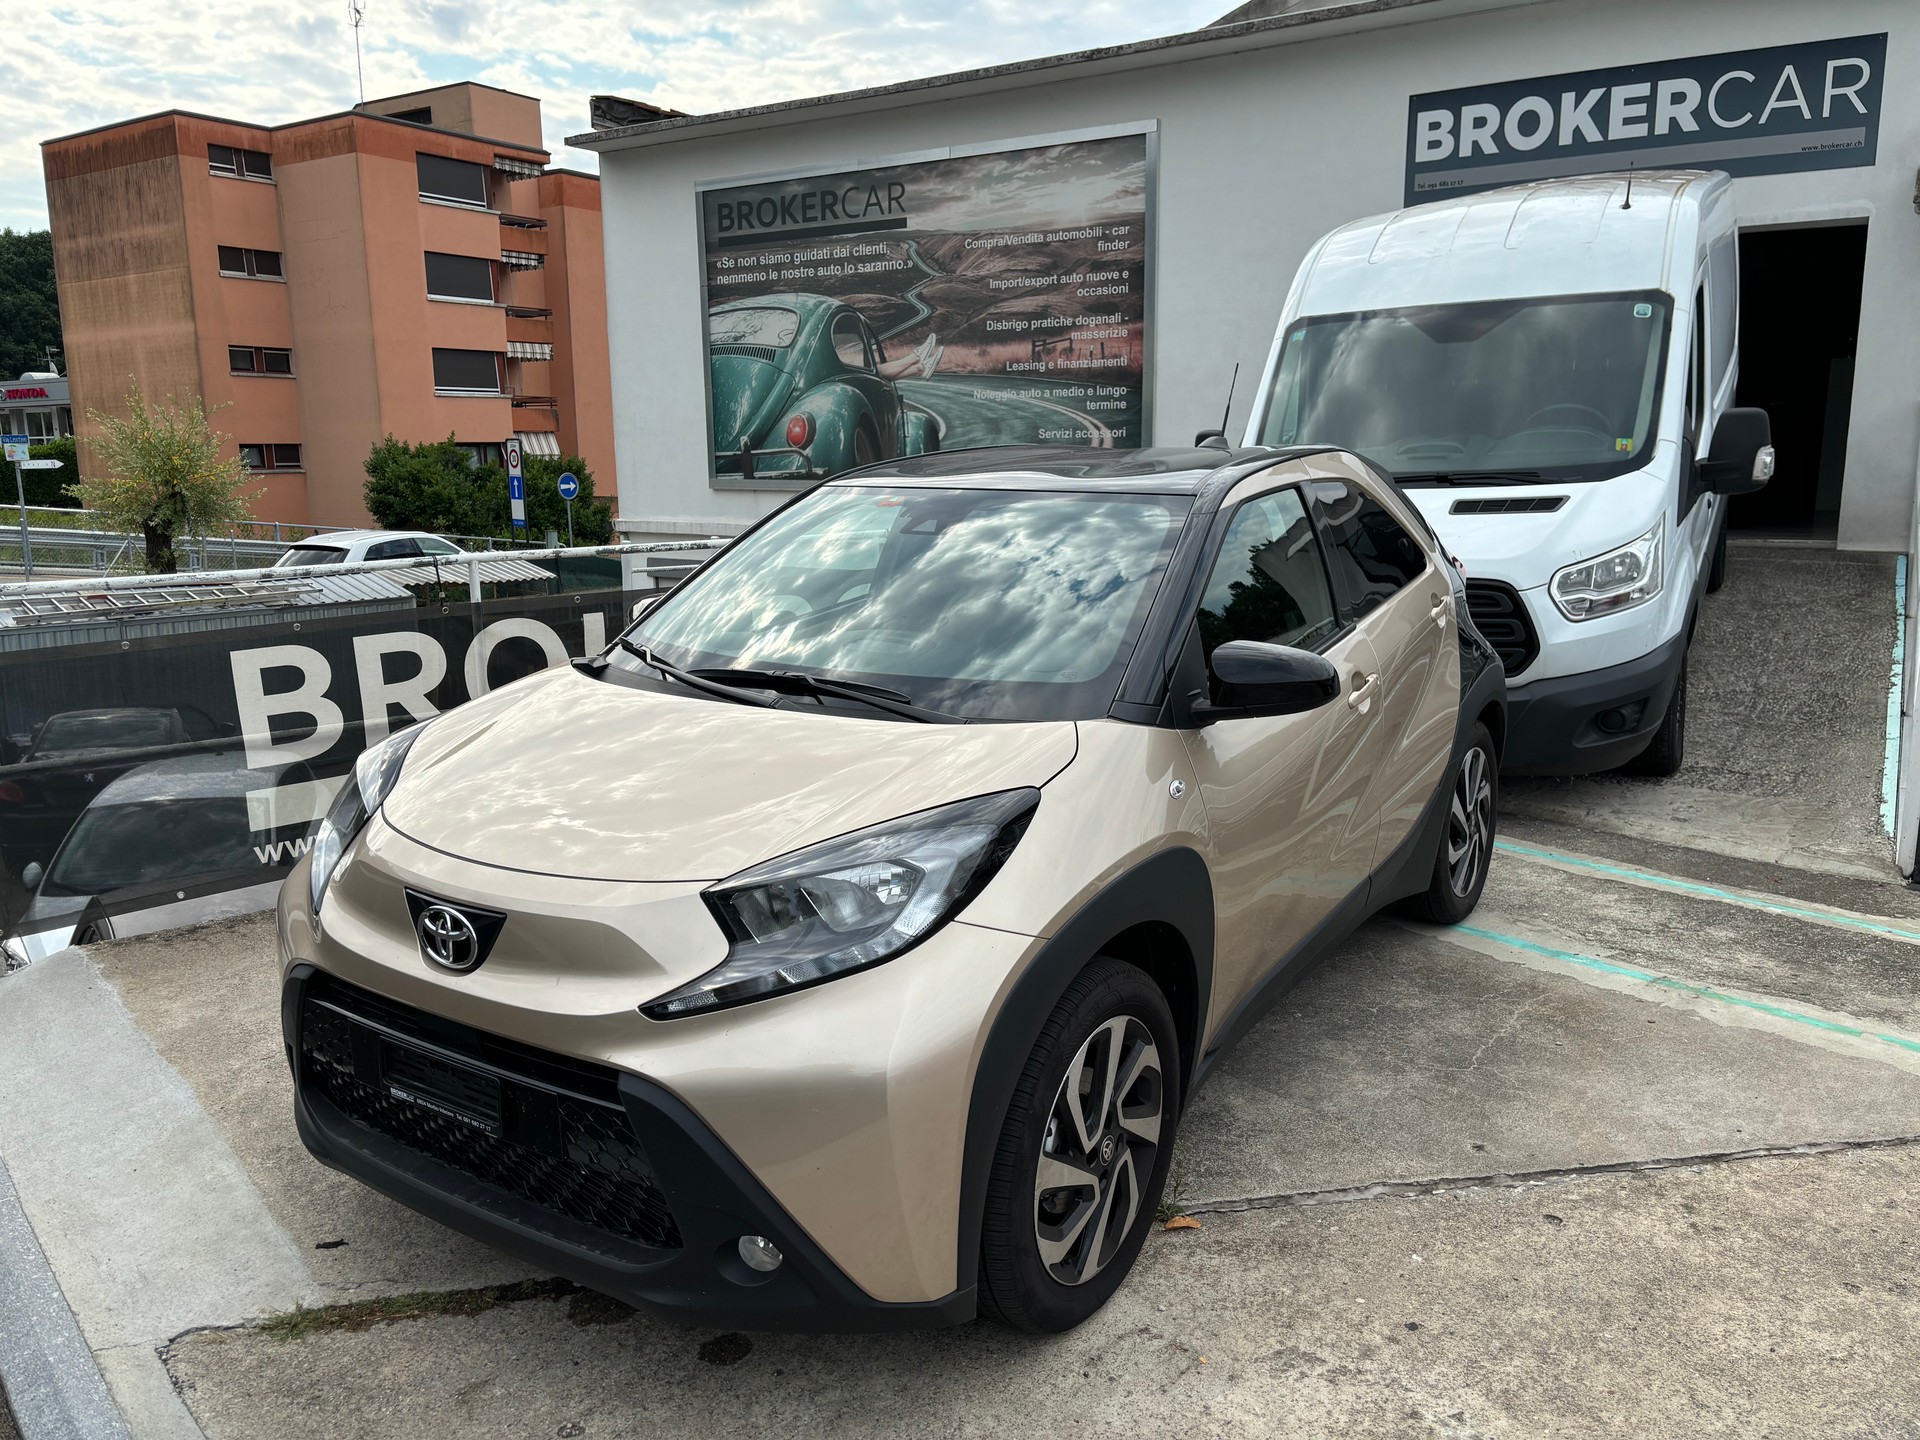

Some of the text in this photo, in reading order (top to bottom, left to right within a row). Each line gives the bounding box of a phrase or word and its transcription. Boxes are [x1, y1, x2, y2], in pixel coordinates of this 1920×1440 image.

[1414, 56, 1872, 163] BROKERCAR
[1801, 140, 1863, 152] www.brokercar.ch
[717, 181, 906, 233] BROKERCAR
[964, 232, 1044, 250] Compra/Vendita
[1046, 226, 1103, 242] automobili
[1112, 225, 1130, 236] car
[1097, 240, 1130, 252] finder
[737, 254, 757, 266] non
[759, 251, 791, 265] siamo
[793, 246, 830, 265] guidati
[833, 243, 850, 257] dai
[852, 241, 890, 257] clienti,
[717, 271, 767, 285] nemmeno
[769, 269, 778, 280] le
[781, 266, 815, 279] nostre
[817, 263, 841, 277] auto
[844, 261, 855, 274] lo
[989, 270, 1129, 291] Import/export auto nuove e
[1077, 283, 1129, 297] occasioni
[986, 318, 1028, 332] Disbrigo
[1030, 314, 1073, 329] pratiche
[1075, 312, 1122, 327] doganali
[1071, 327, 1128, 340] masserizie
[1006, 355, 1128, 372] Leasing e finanziamenti
[6, 387, 48, 399] HONDA
[973, 384, 1127, 401] Noleggio auto a medio e lungo
[1086, 398, 1127, 410] termine
[1038, 426, 1127, 439] Servizi accessori
[253, 835, 318, 864] ww
